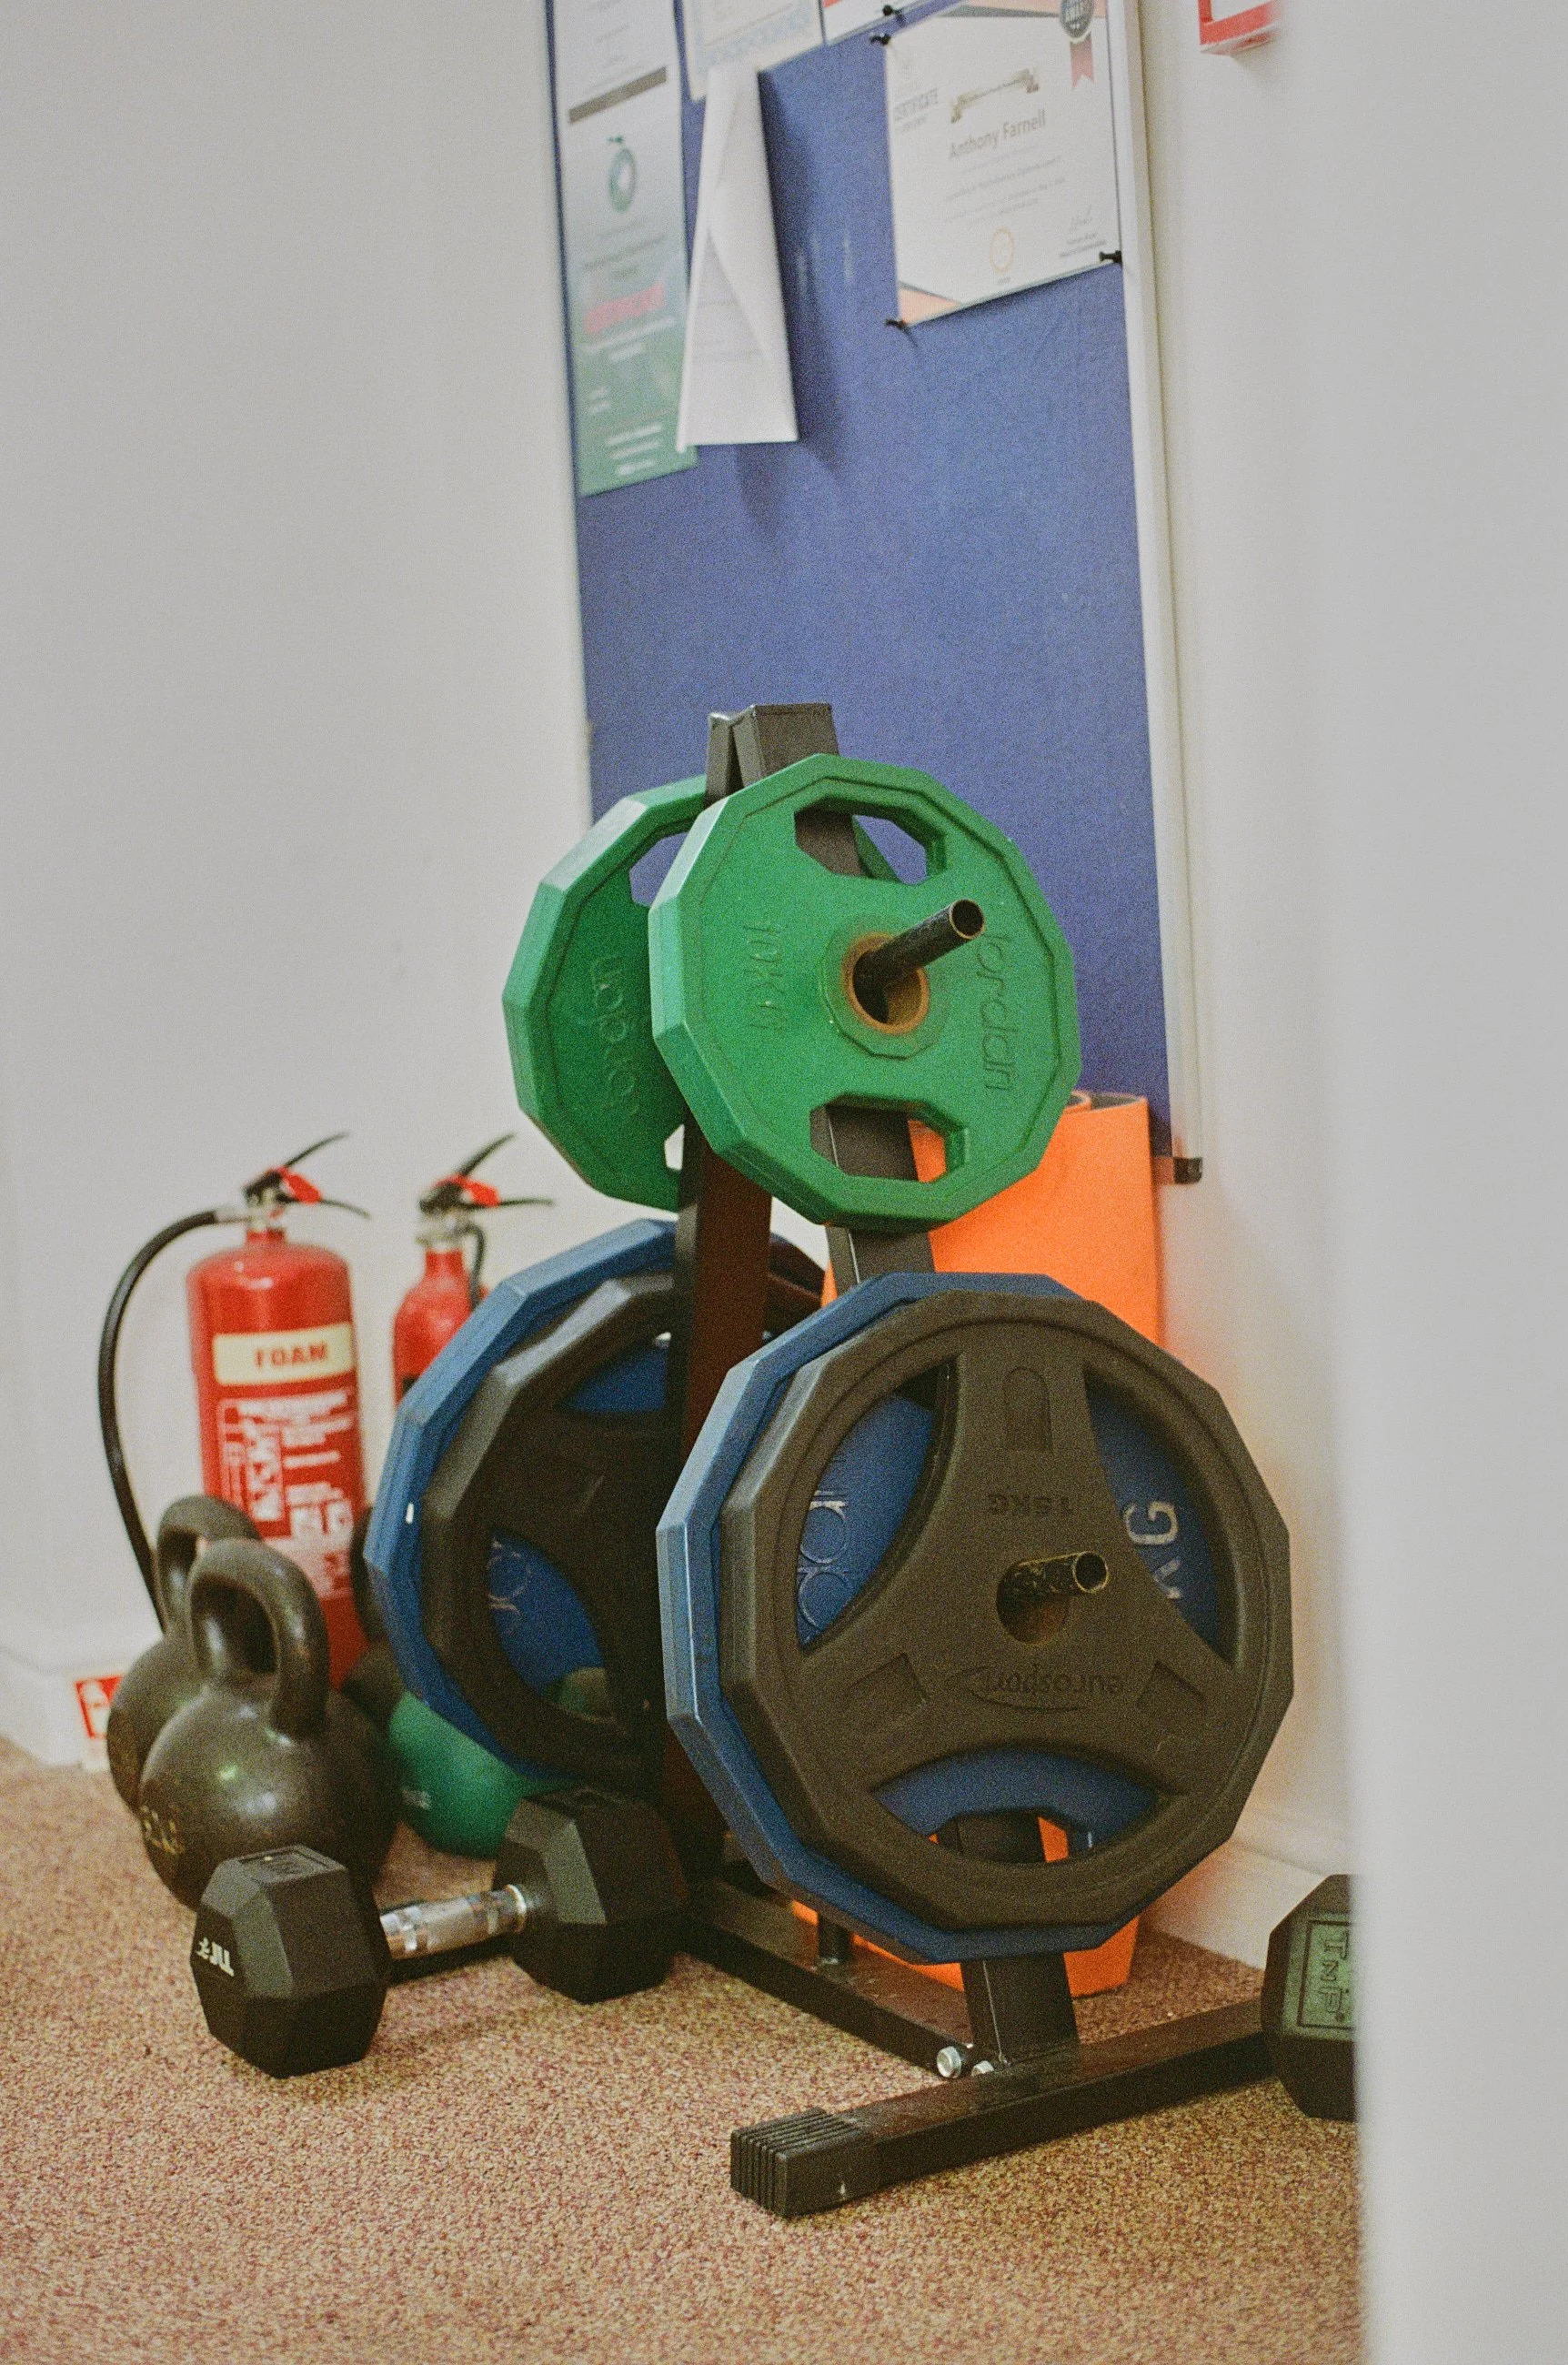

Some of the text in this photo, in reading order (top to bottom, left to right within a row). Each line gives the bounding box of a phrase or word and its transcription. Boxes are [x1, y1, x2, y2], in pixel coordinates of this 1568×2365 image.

[949, 108, 1046, 158] Anthony Farnell
[254, 1340, 329, 1372] FOAM
